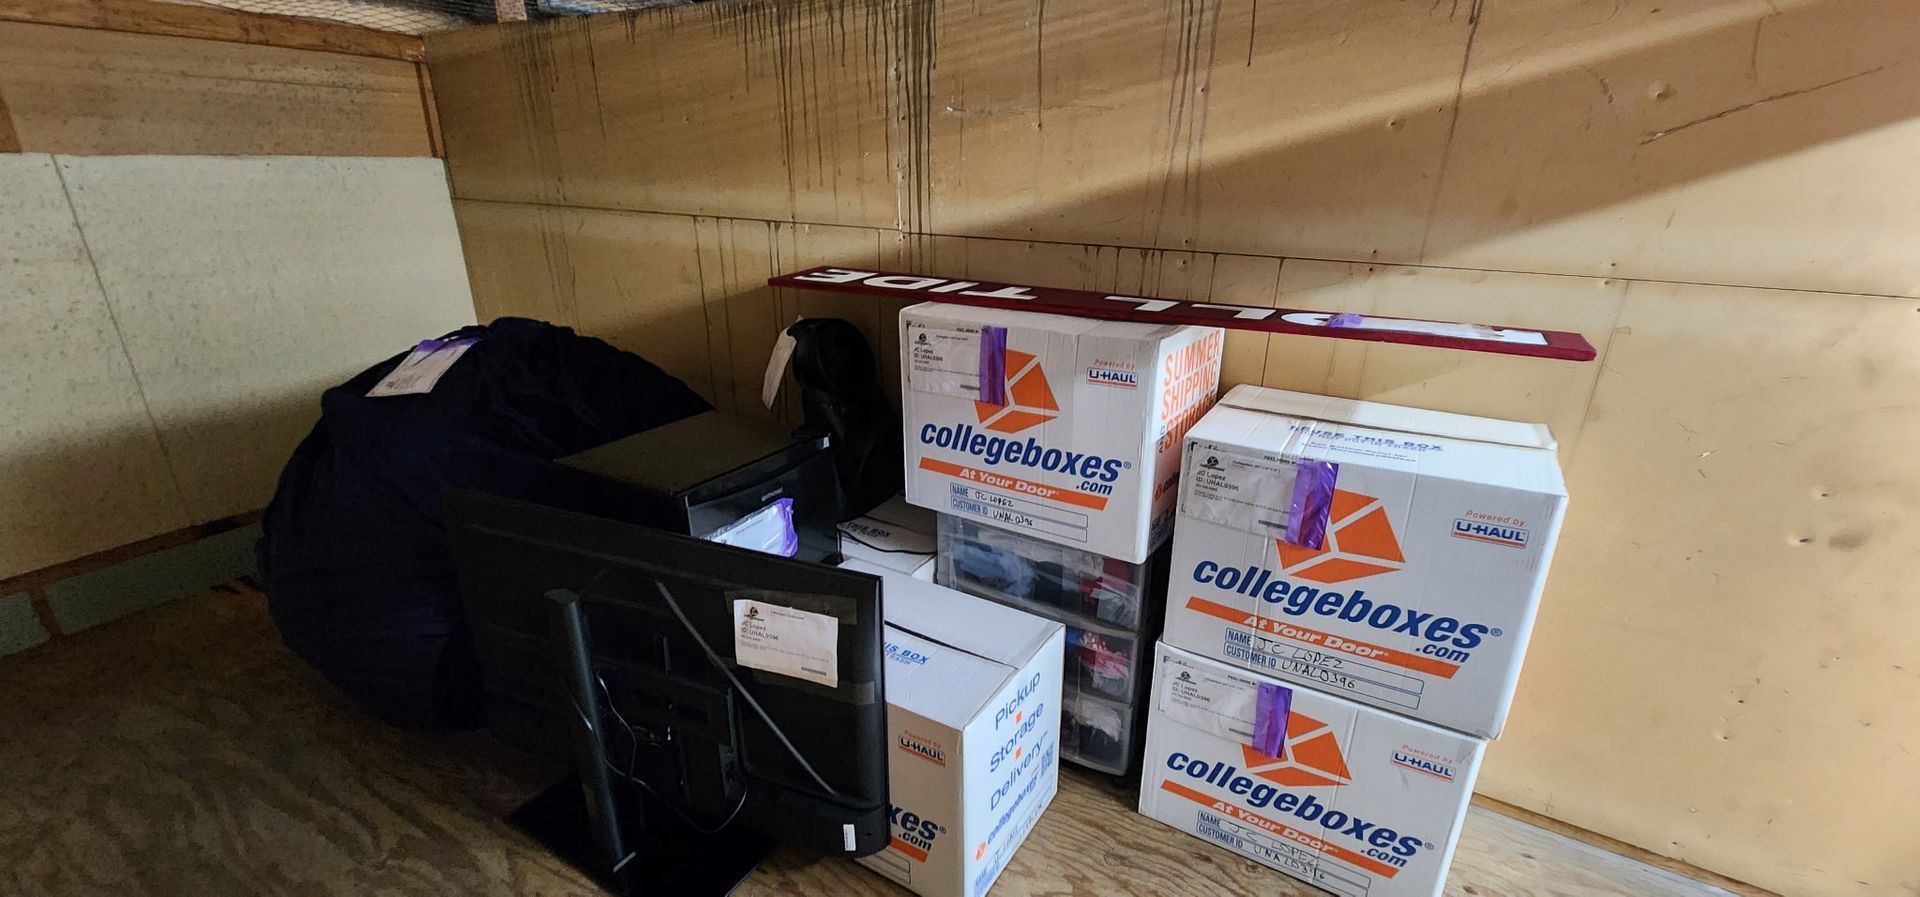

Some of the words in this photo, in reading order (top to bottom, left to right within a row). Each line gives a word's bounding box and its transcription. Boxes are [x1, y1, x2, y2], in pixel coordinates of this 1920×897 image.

[793, 268, 1038, 300] TIDE
[1164, 329, 1220, 387] SUMMER
[1088, 369, 1136, 384] U-HAUL
[1161, 359, 1217, 421] SHIPPING
[952, 483, 969, 497] NAME
[960, 468, 976, 480] At
[980, 471, 1014, 488] Your
[1015, 480, 1056, 497] Door
[1075, 478, 1113, 495] .com
[1466, 509, 1511, 524] Powered
[1513, 518, 1527, 528] by
[1456, 521, 1525, 542] U-HAUL
[1227, 630, 1251, 646] NAME
[1243, 615, 1266, 631] At
[1273, 623, 1322, 643] Your
[1324, 636, 1385, 658] Door
[884, 641, 899, 653] IS
[901, 649, 929, 664] BOX
[1226, 644, 1268, 667] CUSTOMER
[1268, 656, 1277, 668] ID
[1292, 647, 1344, 669] LOPEZ
[1414, 644, 1470, 664] .com
[995, 672, 1040, 731] Pickup
[900, 737, 944, 761] U-HAUL
[990, 702, 1044, 773] Storage
[1394, 752, 1453, 777] U-HAUL
[1200, 812, 1221, 828] NAME
[1212, 801, 1234, 815] At
[1238, 809, 1281, 832] Your
[1283, 826, 1339, 853] Door
[898, 832, 932, 852] .com
[1199, 824, 1236, 847] CUSTOMER
[1235, 839, 1244, 849] ID
[1361, 848, 1408, 868] .com
